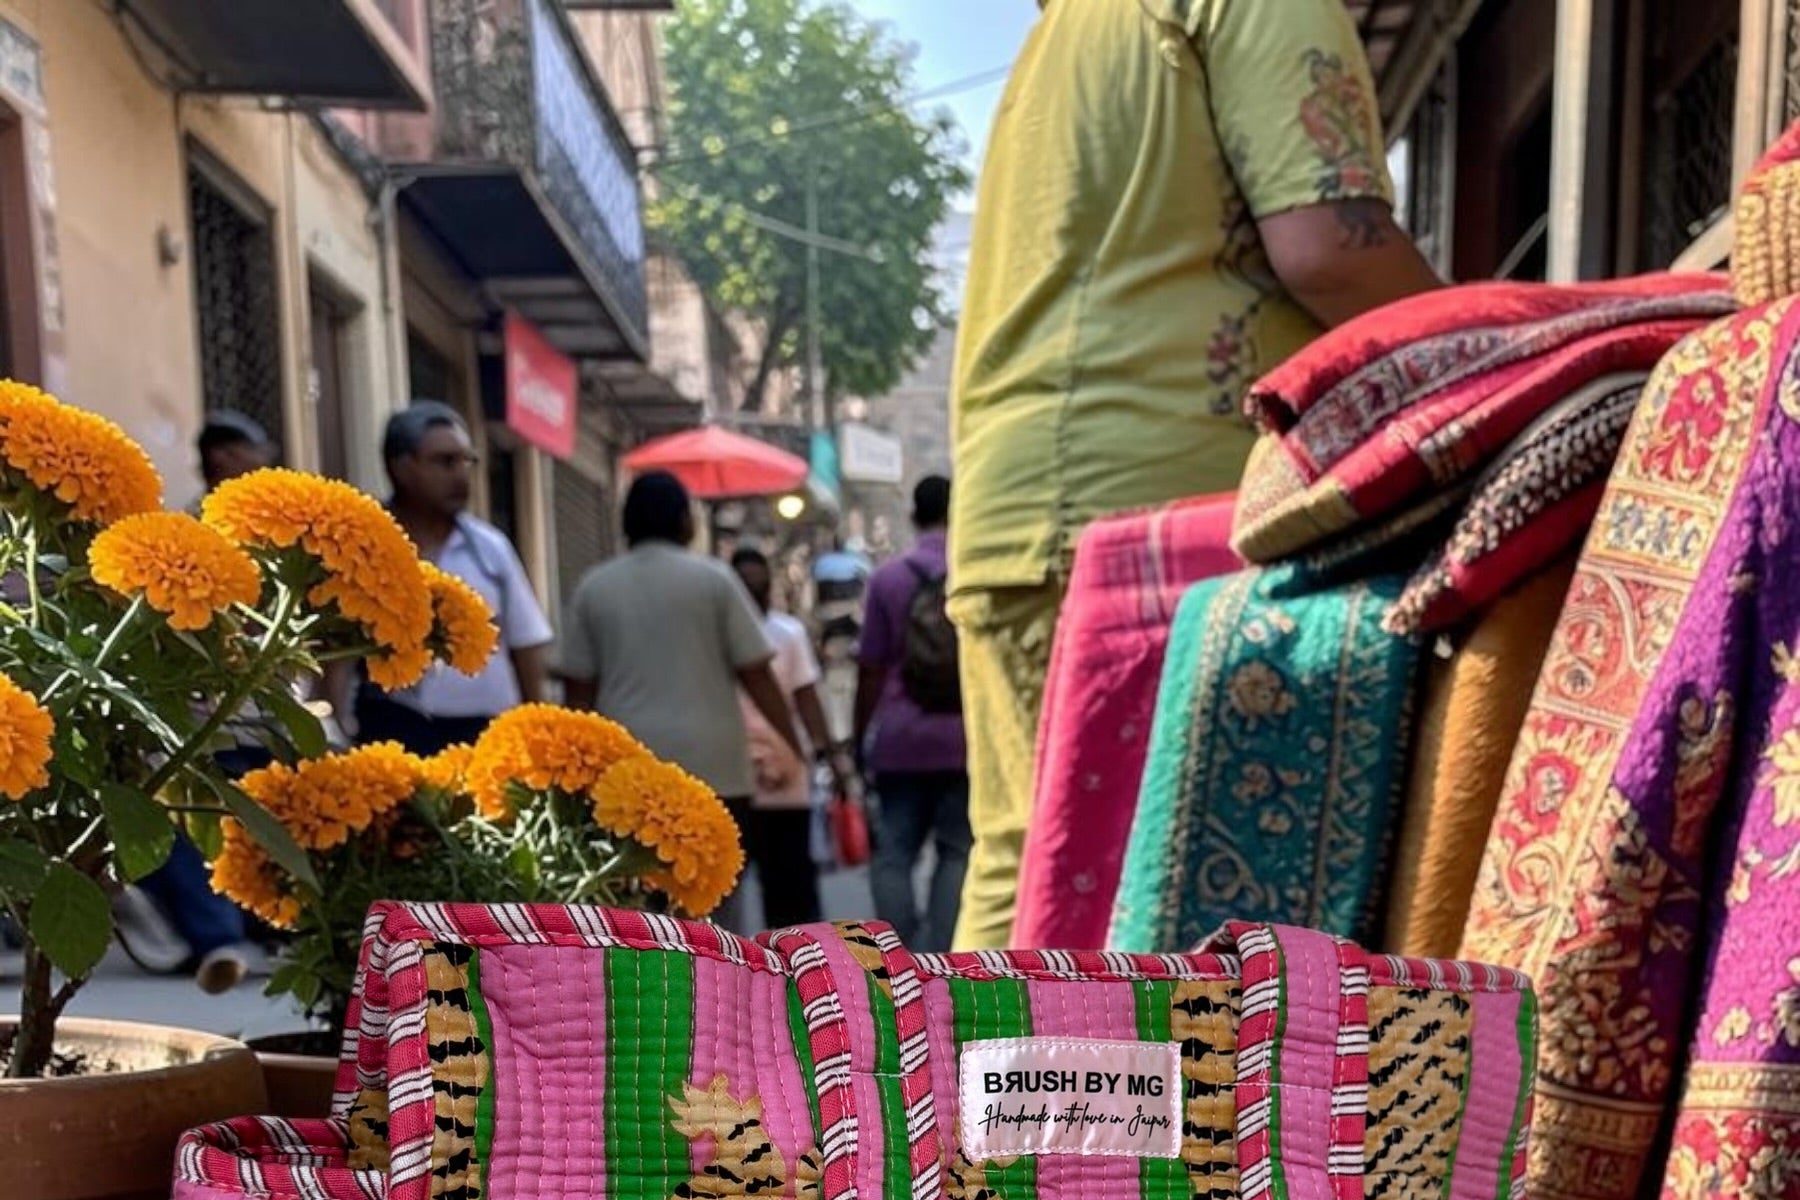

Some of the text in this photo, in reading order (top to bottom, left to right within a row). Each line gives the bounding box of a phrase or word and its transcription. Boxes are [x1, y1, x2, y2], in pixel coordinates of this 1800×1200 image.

[1084, 1072, 1121, 1094] BY
[1127, 1074, 1164, 1097] MG
[978, 1101, 1171, 1138] Handmade with love in Jaipur
